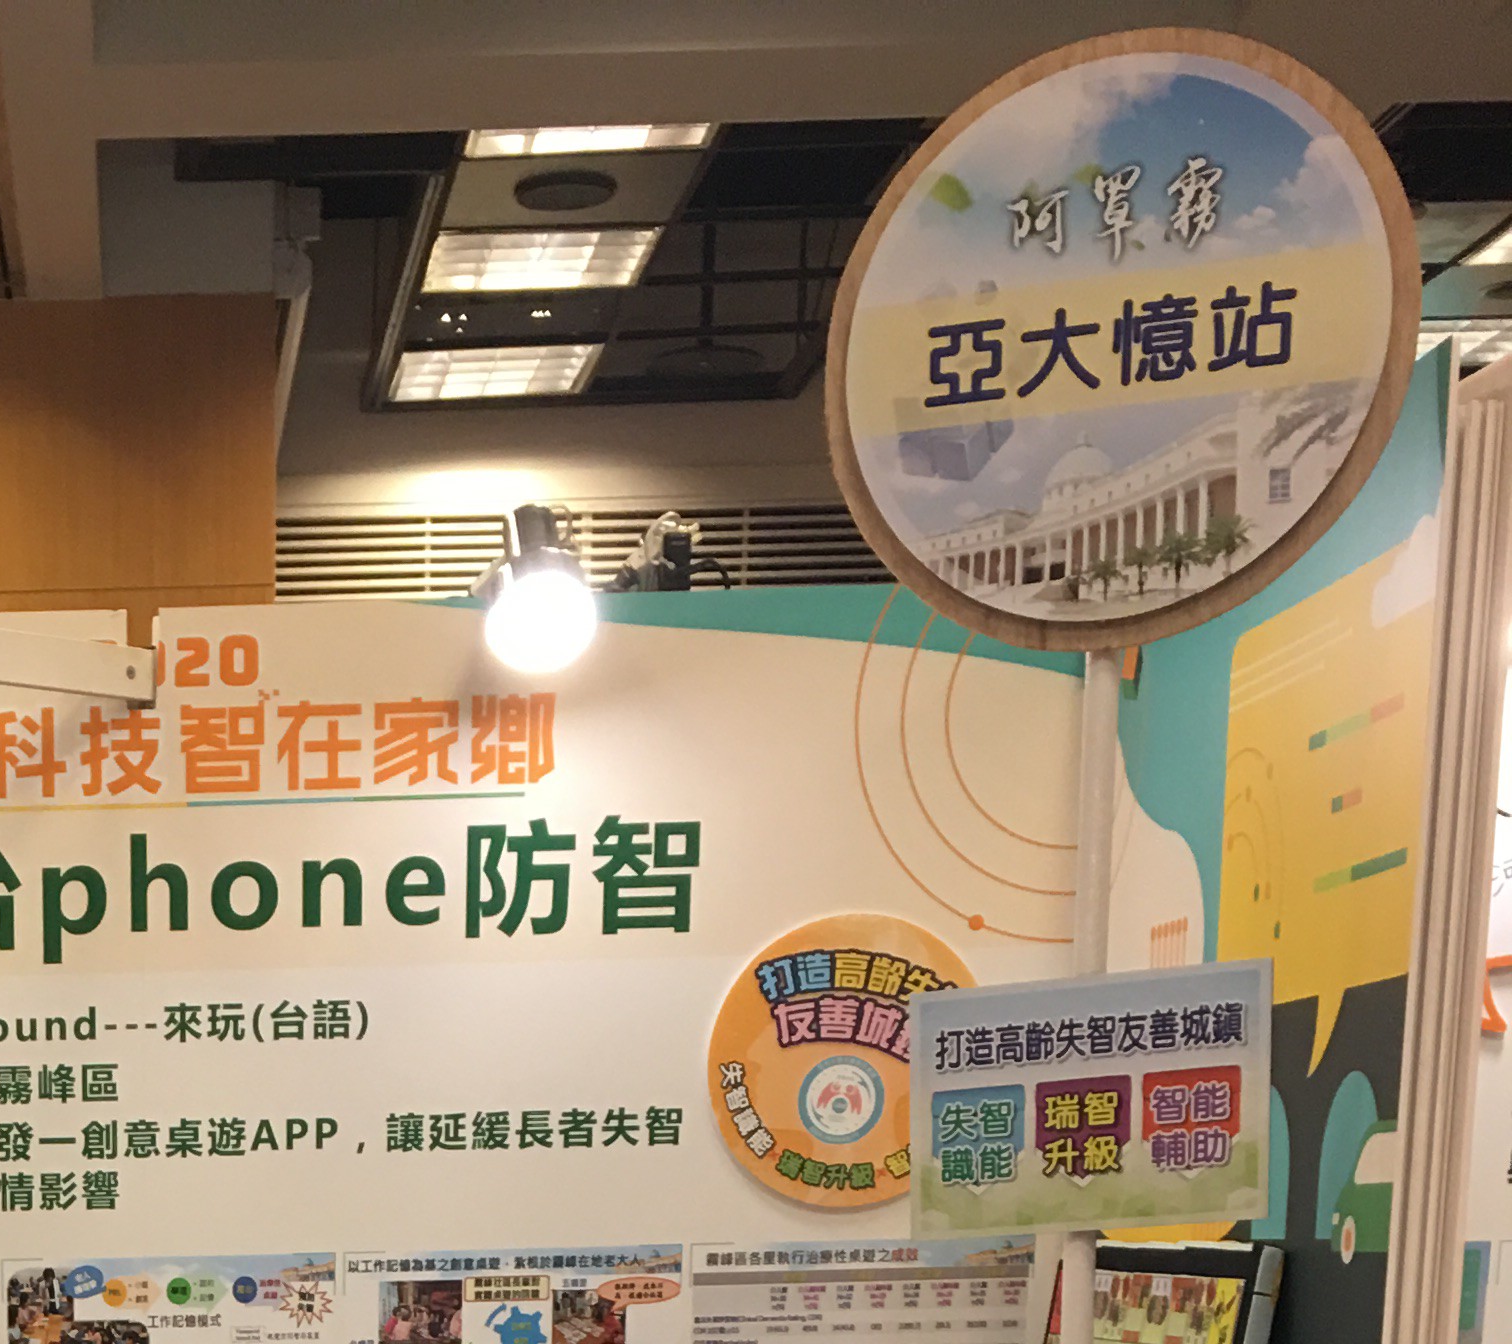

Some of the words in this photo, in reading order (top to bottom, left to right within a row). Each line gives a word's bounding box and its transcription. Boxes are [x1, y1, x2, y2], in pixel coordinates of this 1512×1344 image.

[1006, 157, 1226, 263] 阿罩霧
[924, 281, 1298, 408] 亞大憶站
[157, 634, 259, 688] 20
[755, 948, 960, 1004] 打造高齡失
[934, 1001, 1249, 1071] 打造高齡失智友善城鎮
[939, 1099, 1016, 1141] 失智
[1043, 1088, 1121, 1130] 瑞智
[1151, 1079, 1231, 1123] 智能
[940, 1144, 1015, 1187] 識能
[1042, 1133, 1121, 1177] 升級
[1150, 1128, 1233, 1170] 輔助
